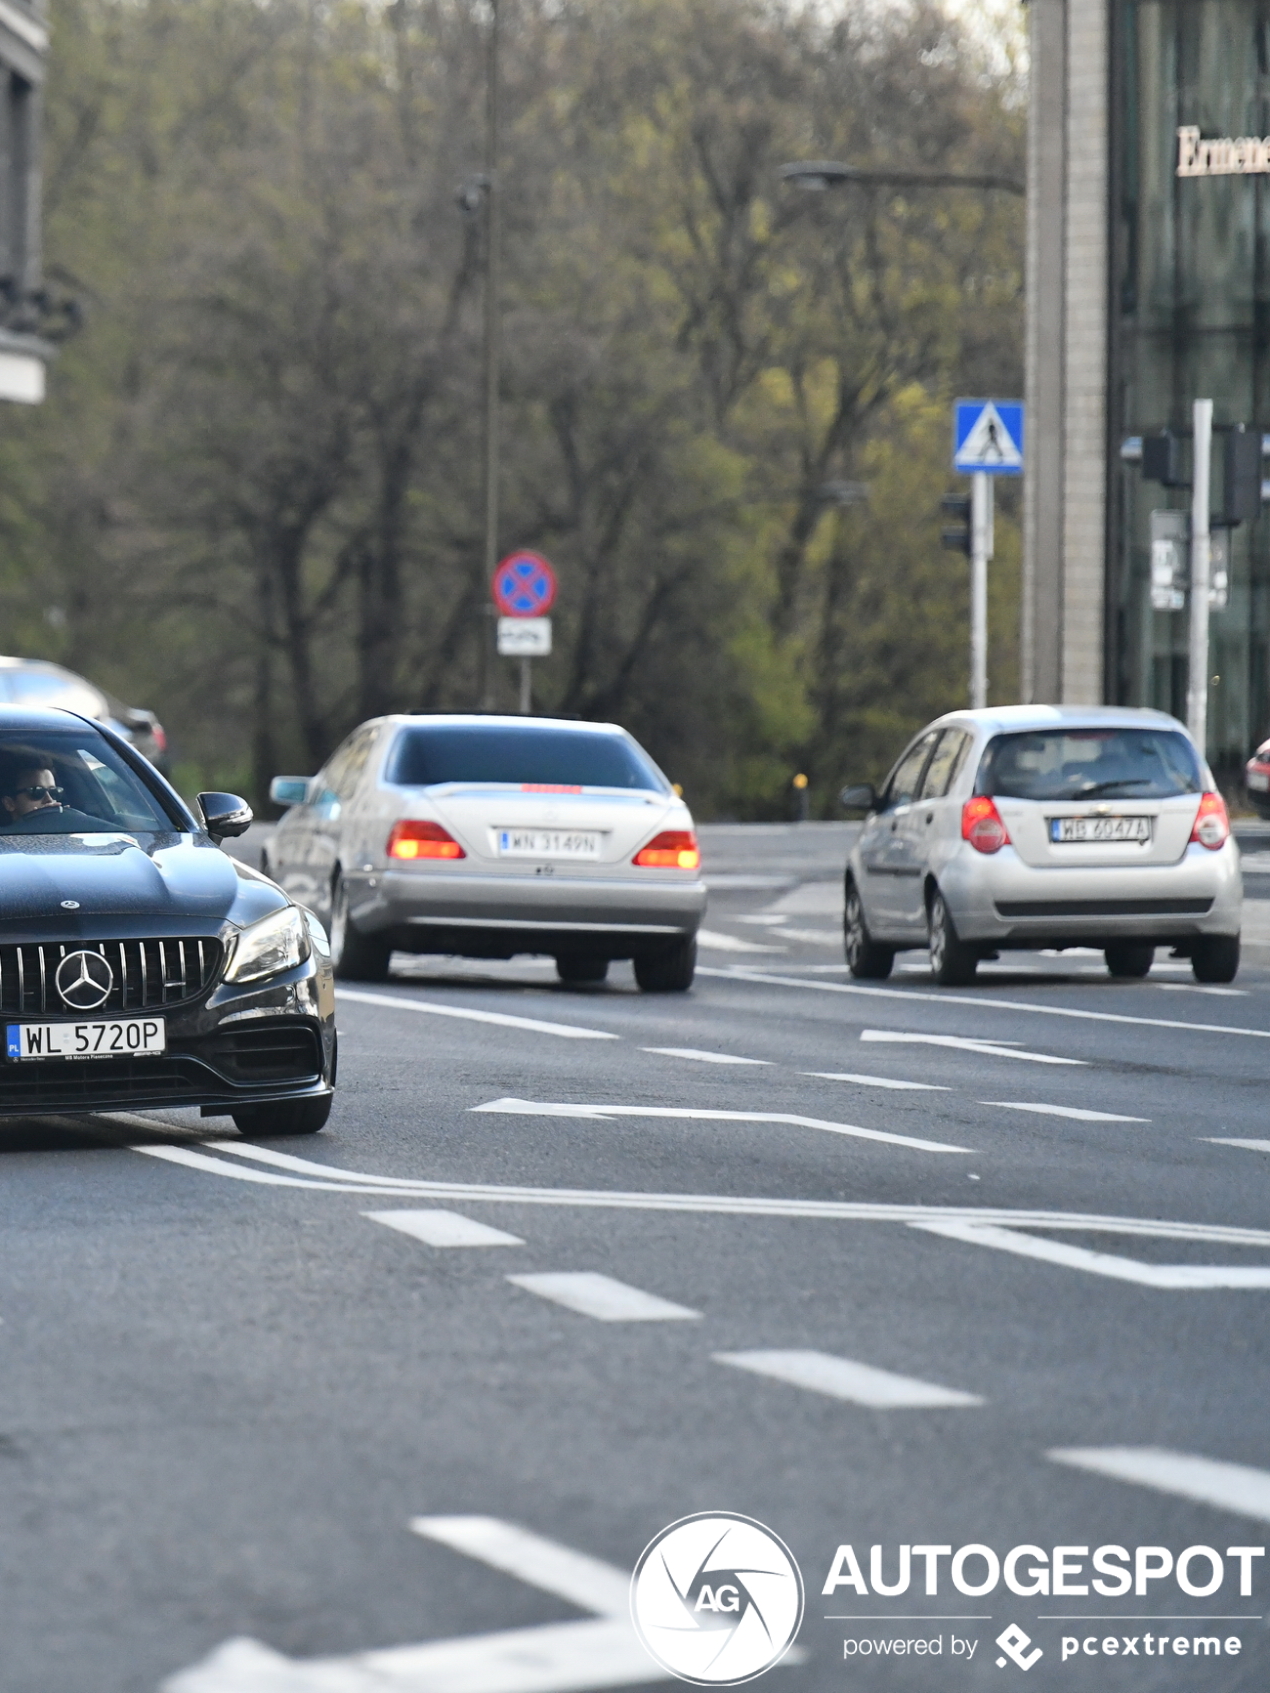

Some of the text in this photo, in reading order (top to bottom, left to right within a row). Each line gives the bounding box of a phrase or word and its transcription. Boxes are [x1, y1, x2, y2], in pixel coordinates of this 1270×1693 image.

[1094, 818, 1145, 839] 6047A
[9, 1044, 19, 1052] PL
[26, 1022, 158, 1054] WL 5720P
